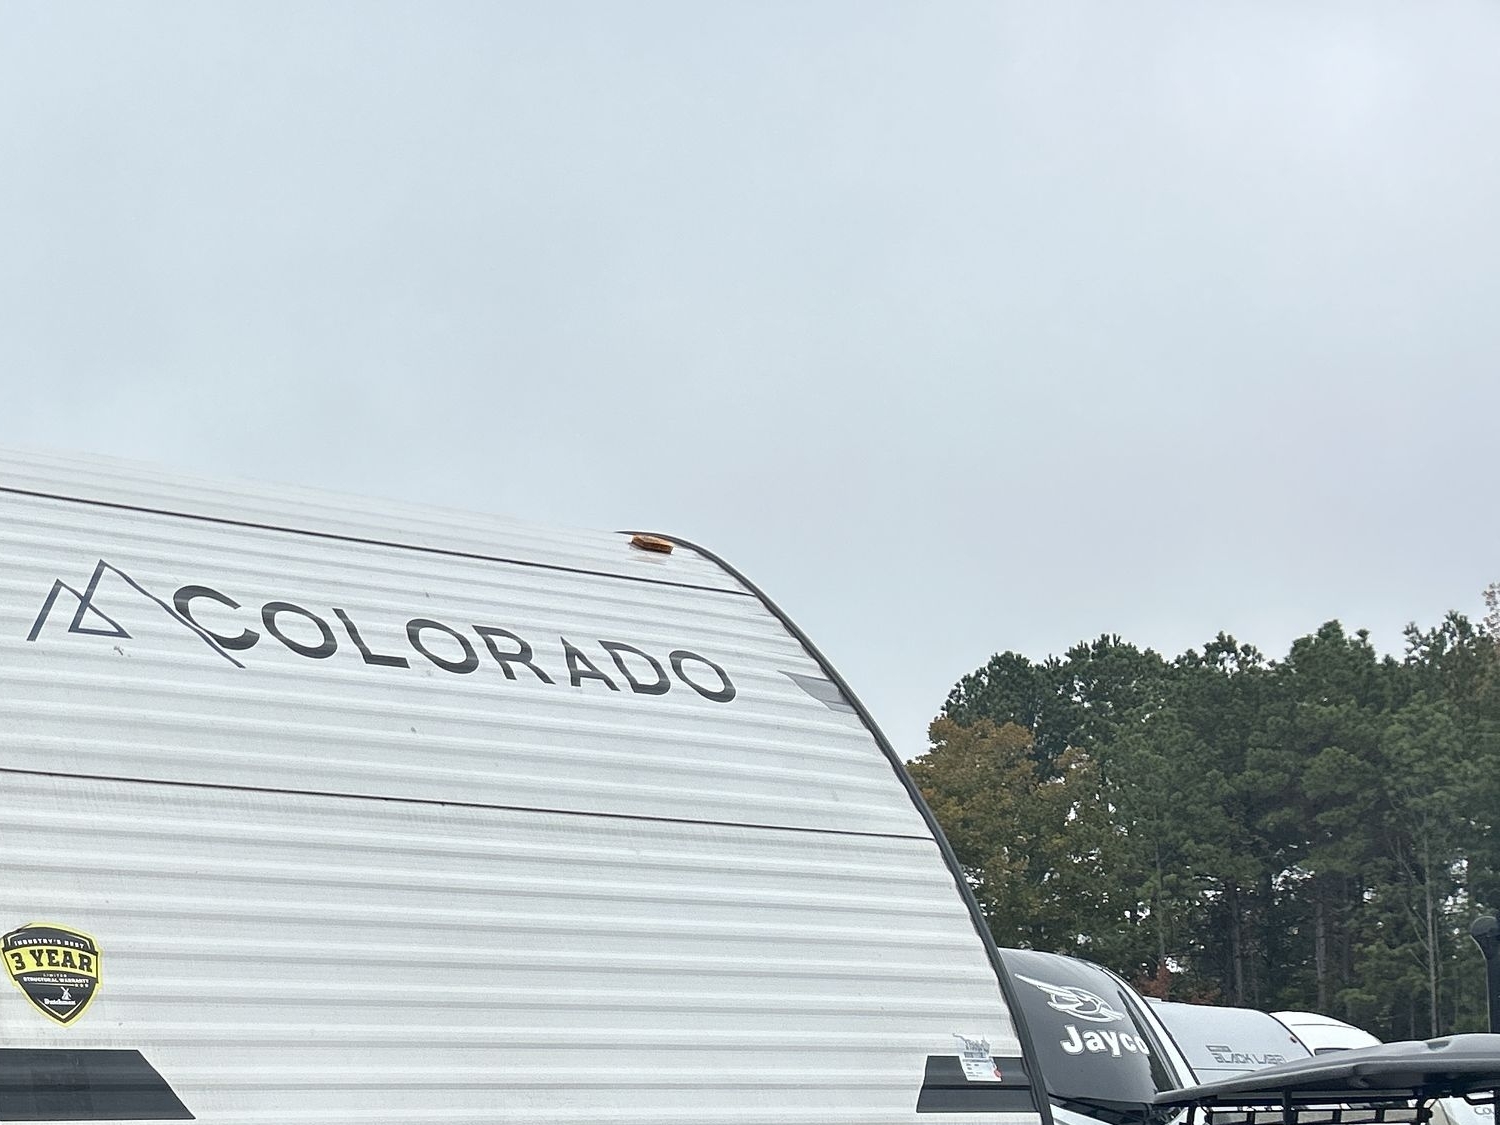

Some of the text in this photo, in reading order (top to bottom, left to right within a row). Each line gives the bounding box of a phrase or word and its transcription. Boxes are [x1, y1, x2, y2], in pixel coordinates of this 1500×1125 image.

[172, 584, 738, 703] COLORADO
[10, 949, 92, 973] 3 YEAR
[1060, 1024, 1150, 1058] Jayco
